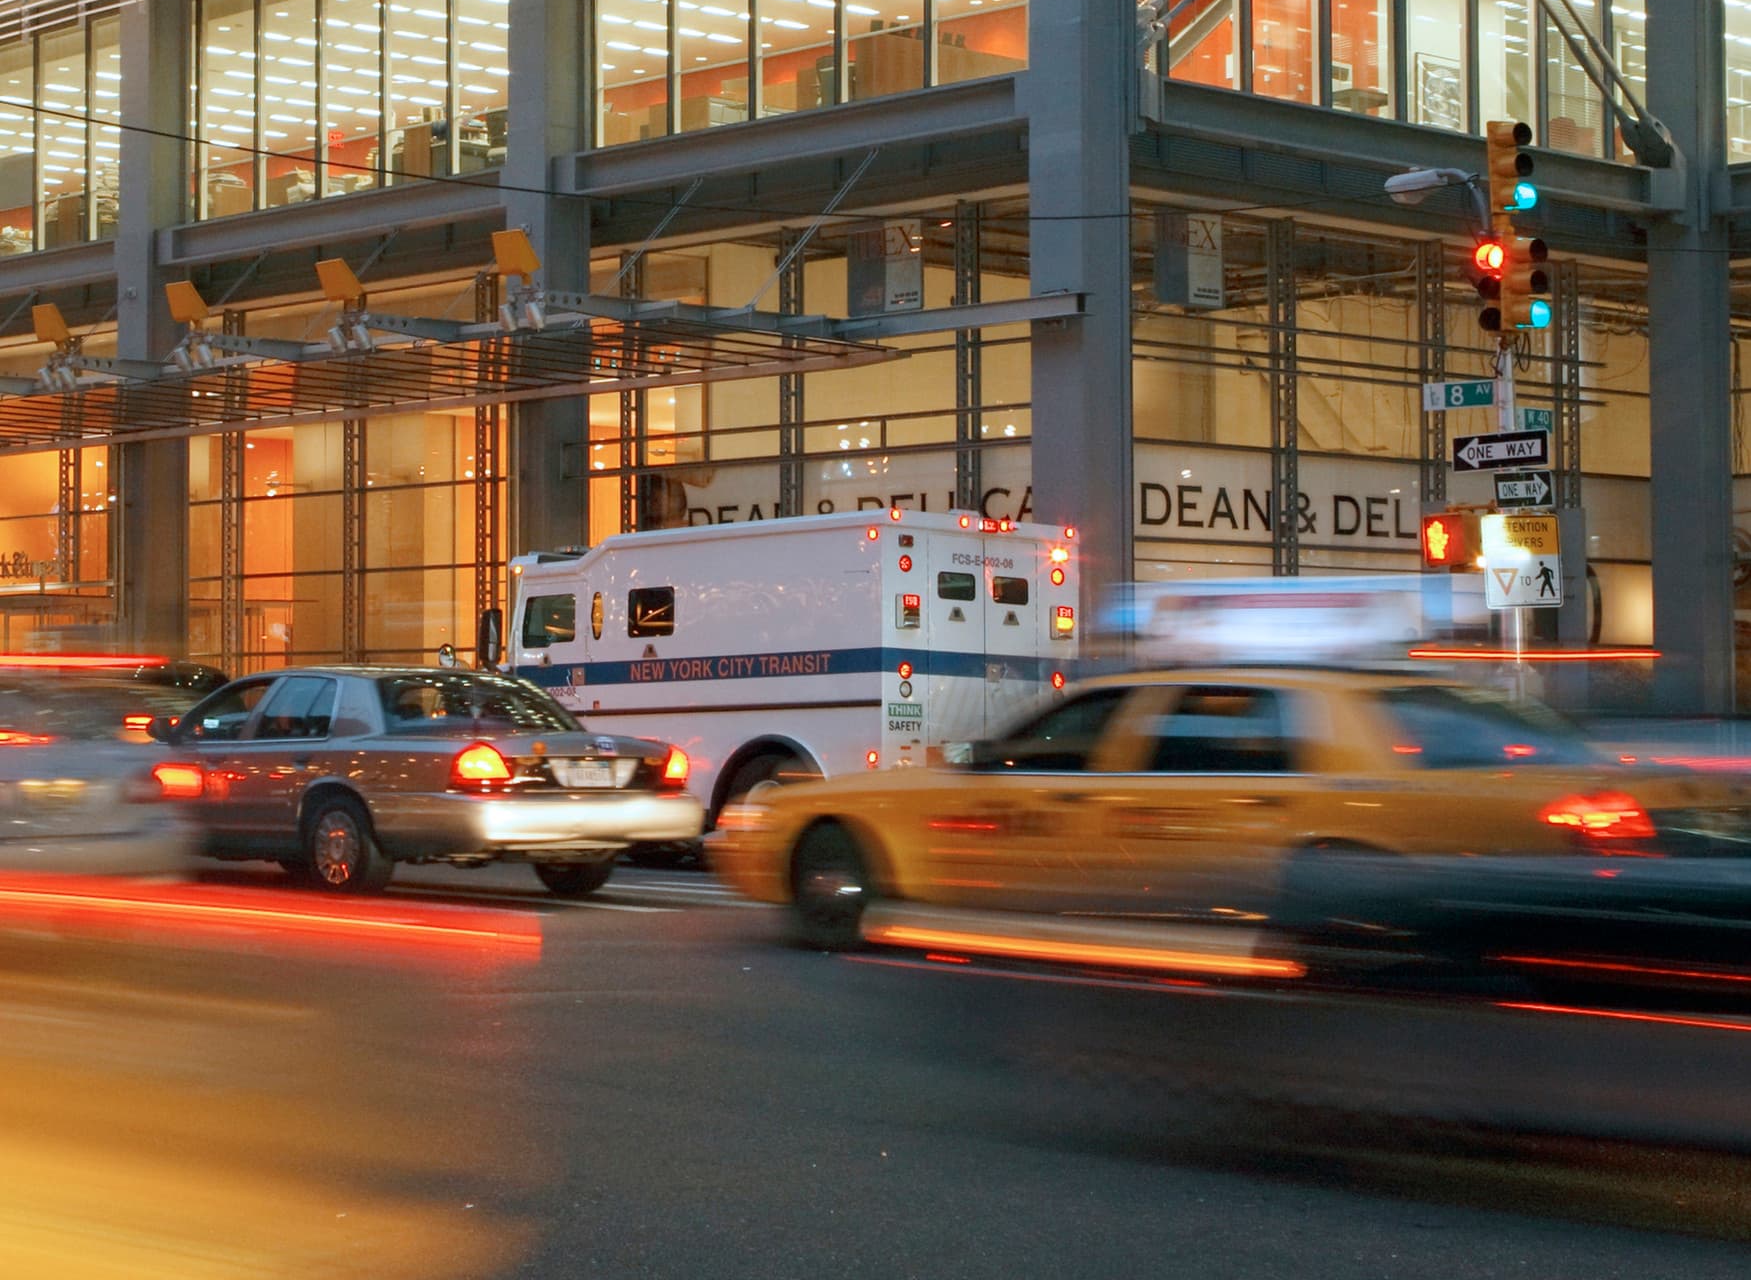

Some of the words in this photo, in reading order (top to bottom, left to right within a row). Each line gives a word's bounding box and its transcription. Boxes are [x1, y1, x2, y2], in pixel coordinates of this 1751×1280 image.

[1450, 385, 1465, 406] 8
[1475, 383, 1491, 395] AV
[1527, 410, 1536, 425] W
[1537, 411, 1550, 425] 40
[1466, 445, 1494, 460] ONE
[1505, 441, 1536, 457] WAY
[1502, 483, 1519, 497] ONE
[1525, 480, 1543, 496] WAY
[1140, 482, 1273, 532] DEAN
[1520, 575, 1532, 586] TO
[630, 663, 665, 681] NEW
[669, 660, 713, 680] YORK
[717, 656, 754, 678] CITY
[759, 653, 832, 675] TRANSIT
[889, 705, 922, 717] THINK
[888, 720, 922, 732] SAFETY
